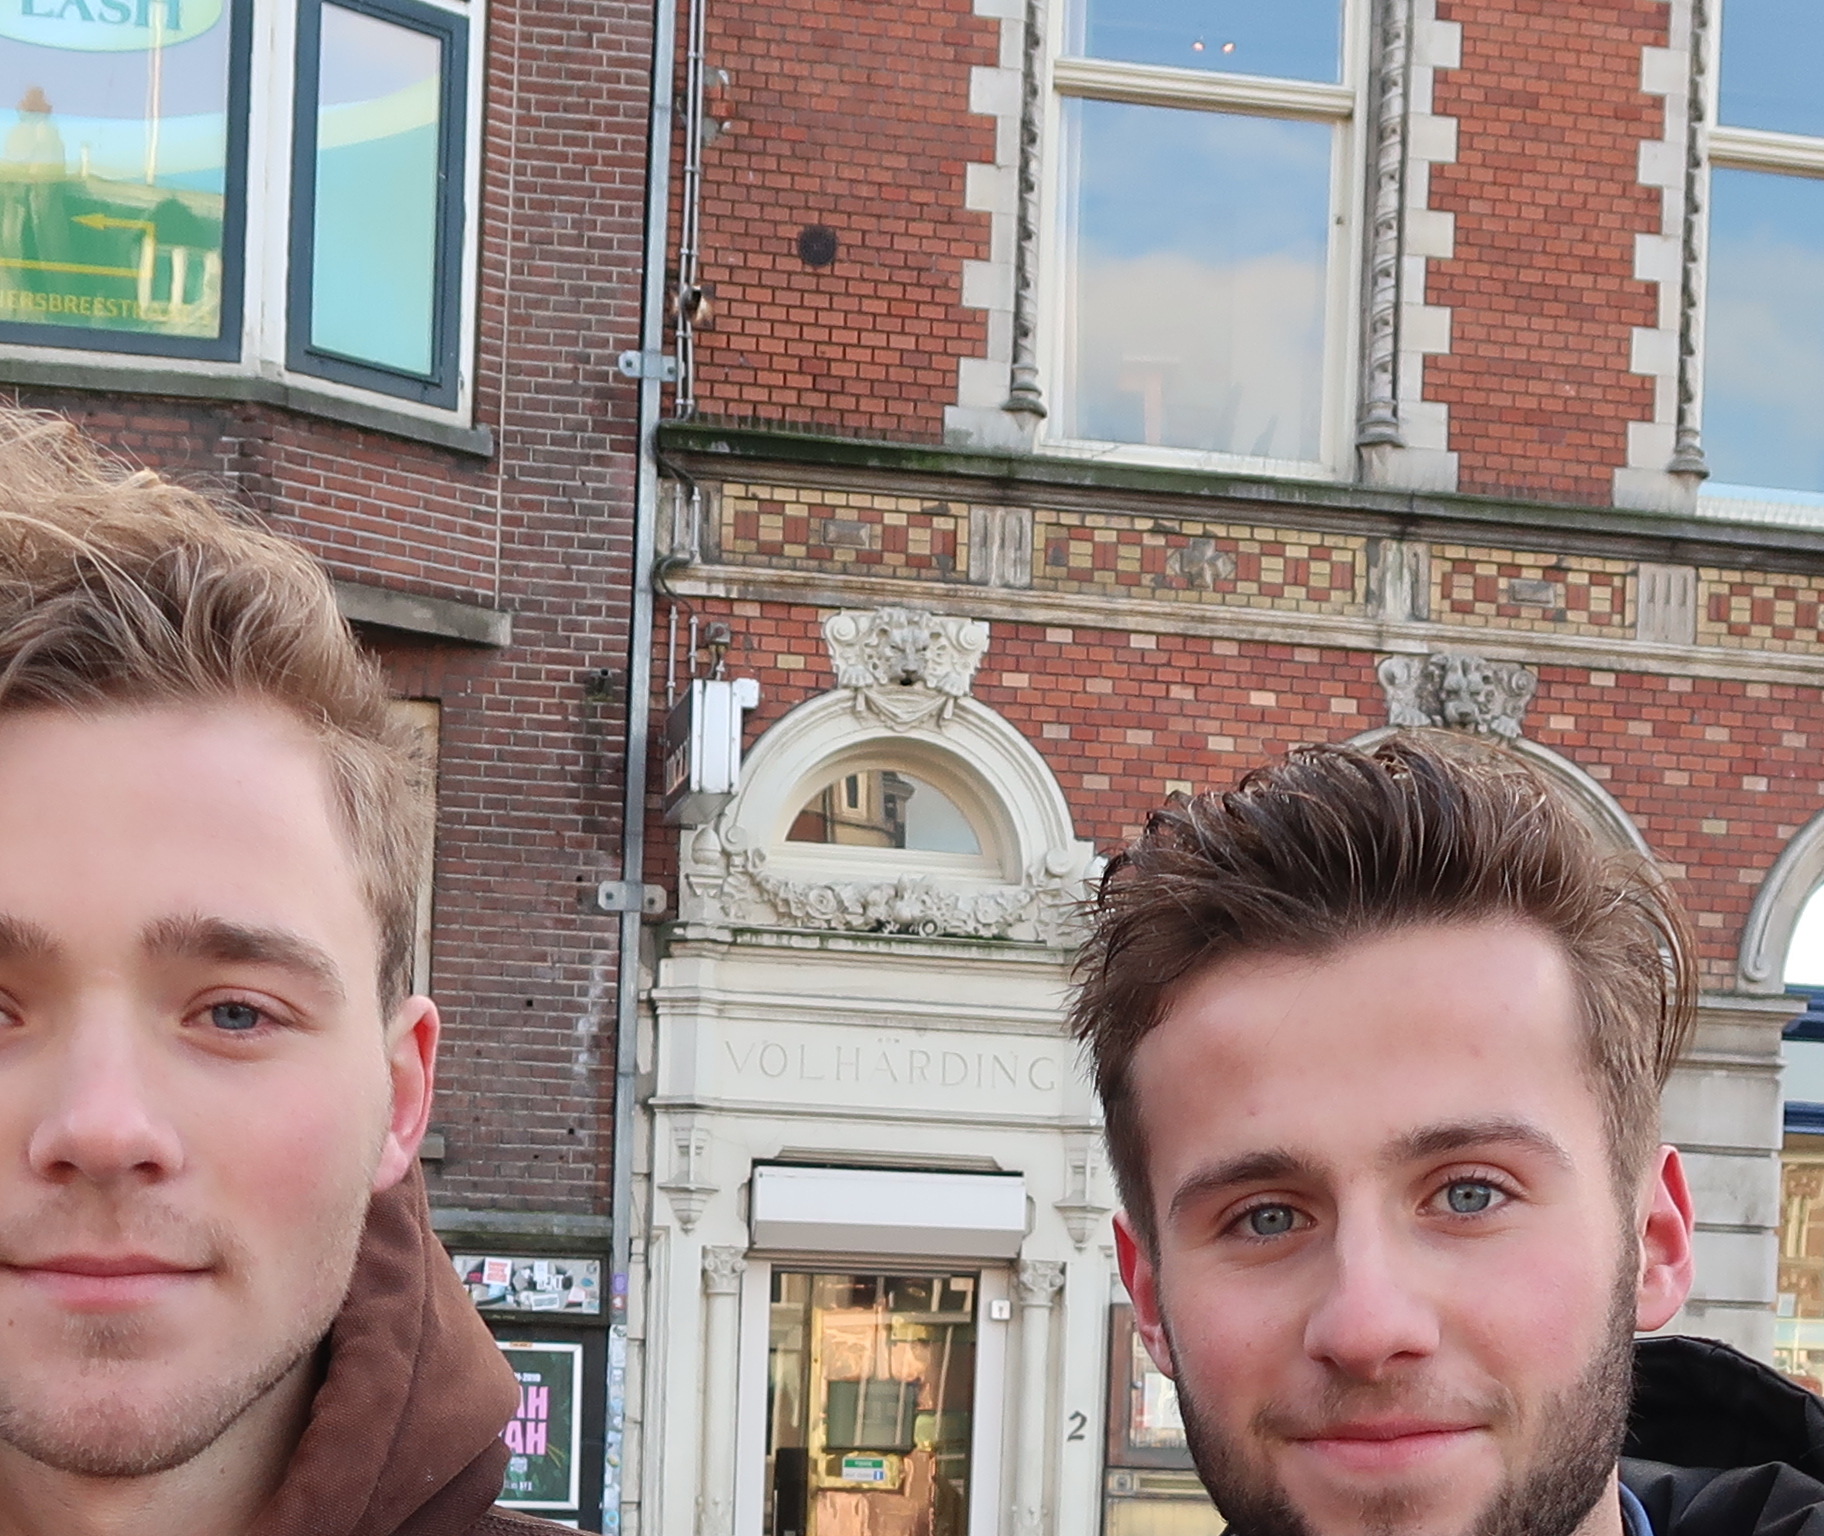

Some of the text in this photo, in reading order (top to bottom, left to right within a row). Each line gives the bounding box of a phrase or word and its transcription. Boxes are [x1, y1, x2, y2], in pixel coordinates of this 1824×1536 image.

[723, 1039, 1057, 1092] VOLHARDING
[505, 1420, 547, 1455] AH
[1067, 1410, 1088, 1441] 2
